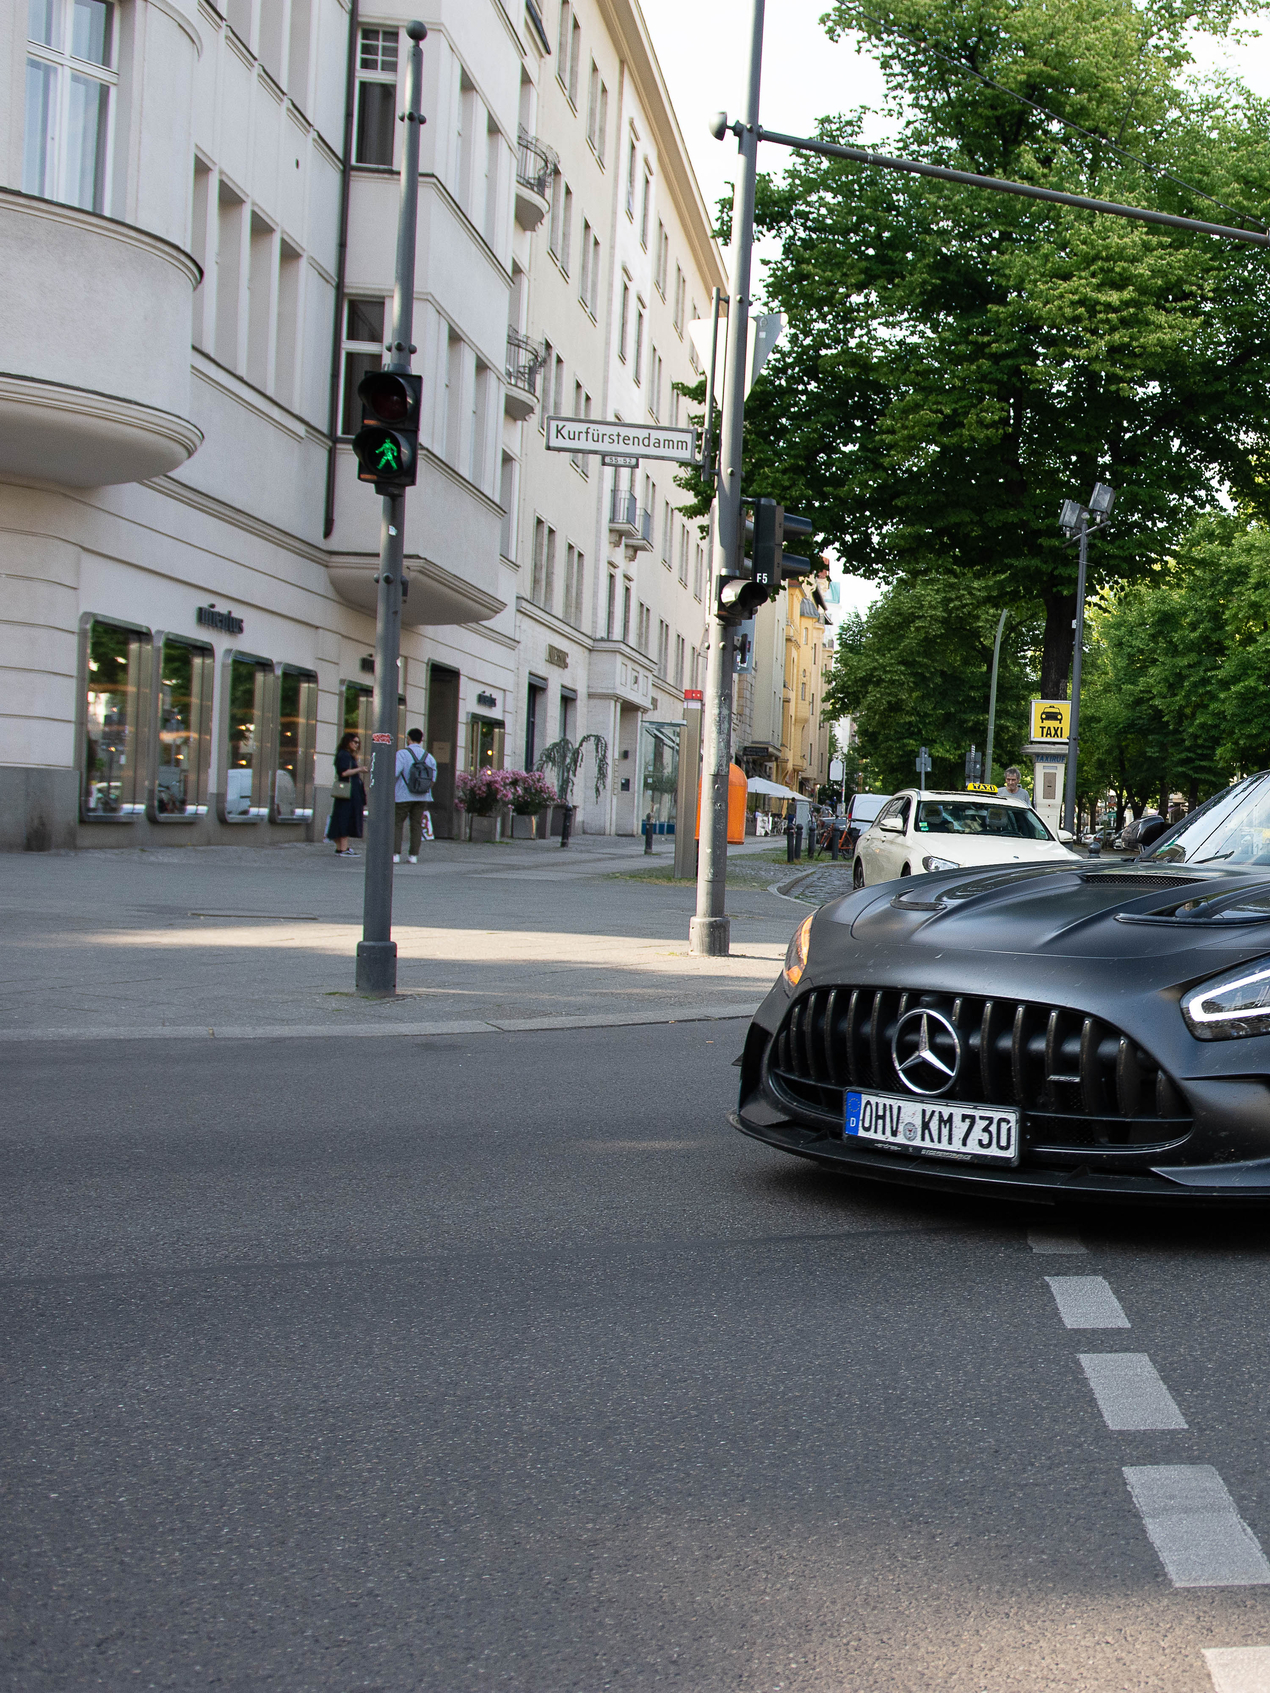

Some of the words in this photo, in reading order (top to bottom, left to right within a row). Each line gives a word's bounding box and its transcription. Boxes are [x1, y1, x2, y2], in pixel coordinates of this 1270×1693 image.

[555, 423, 688, 451] Kurfürstendamm
[756, 572, 768, 584] F5
[1039, 726, 1063, 738] TAXI
[1035, 754, 1066, 763] TAXIRUF
[850, 1117, 857, 1127] D
[861, 1100, 902, 1138] OHV
[920, 1108, 953, 1146] KM
[961, 1113, 1011, 1151] 730
